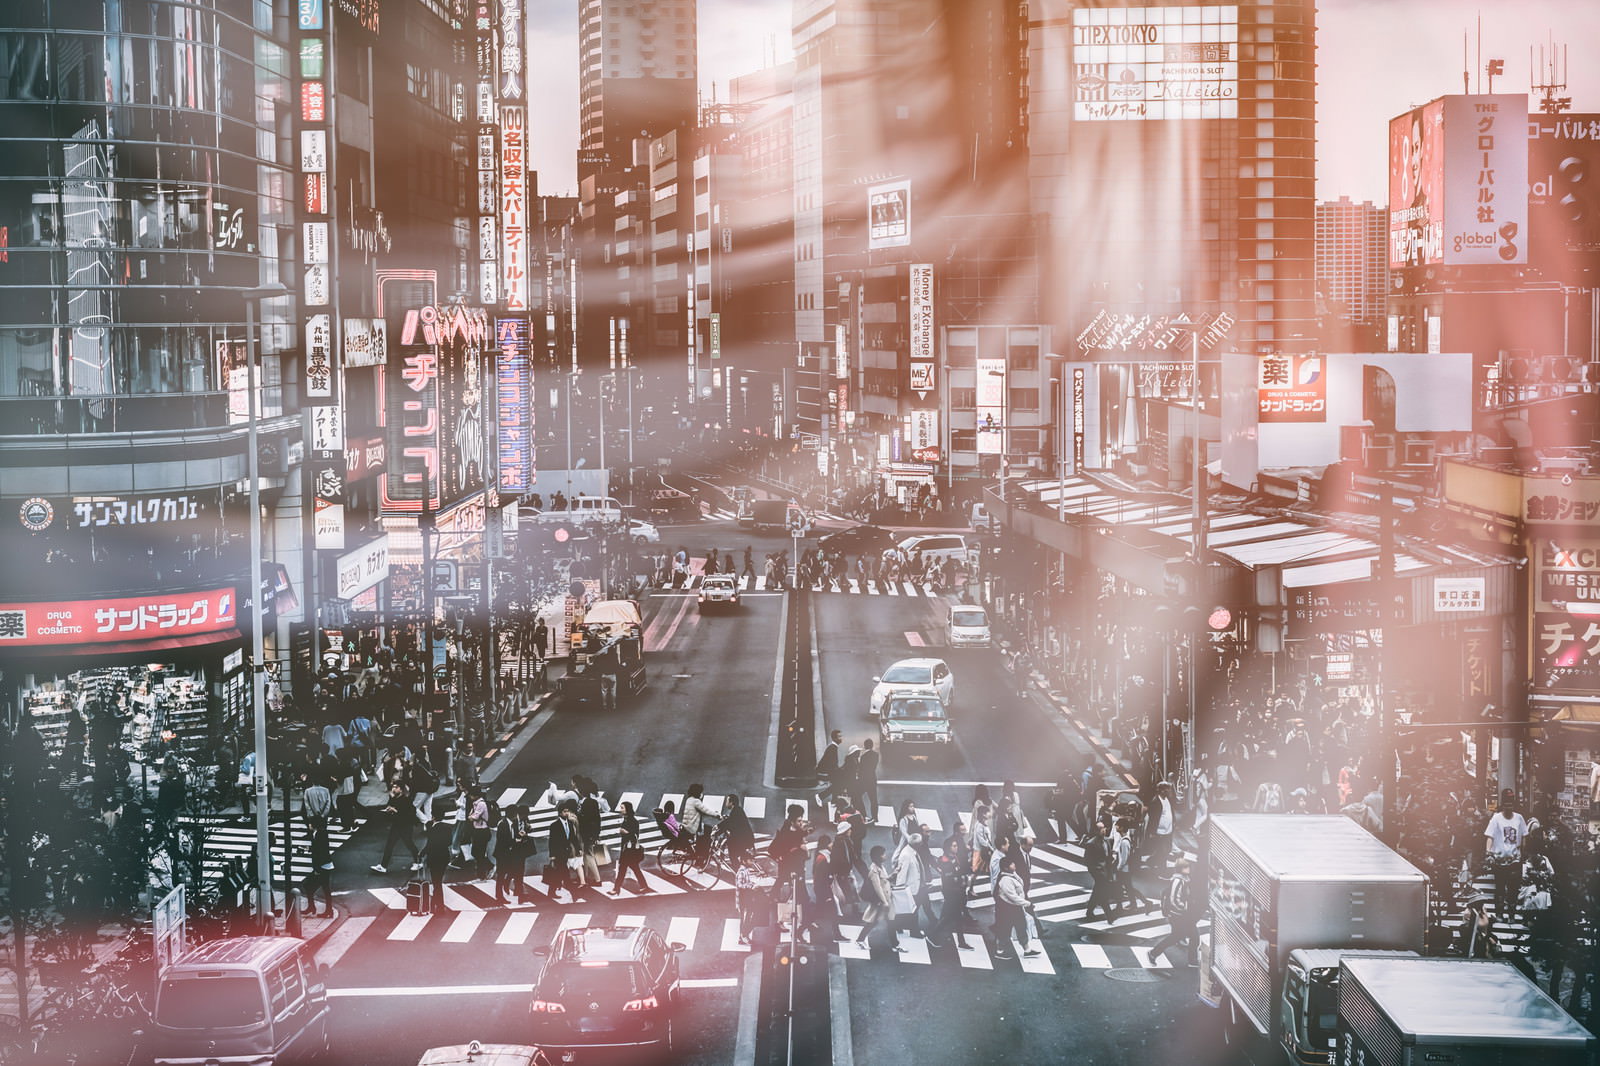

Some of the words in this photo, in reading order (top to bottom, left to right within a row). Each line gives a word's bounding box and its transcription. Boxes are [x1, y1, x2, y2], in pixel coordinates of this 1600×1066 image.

[1114, 26, 1158, 43] TOKYO
[1206, 67, 1225, 75] SLOT
[1153, 78, 1234, 99] Kaleido
[1474, 103, 1499, 113] THE
[479, 127, 492, 135] 4F
[1528, 117, 1600, 141] ローバル社
[1477, 116, 1495, 223] グローバル社
[503, 109, 524, 308] 100名収容大パーティールーム
[1453, 231, 1497, 253] global
[922, 268, 931, 302] Money
[1078, 314, 1119, 356] Kaleido
[1199, 311, 1236, 350] TIPNESS
[1263, 358, 1289, 385] 薬
[400, 306, 438, 484] パチンコ
[500, 312, 522, 488] パチンコジャンボ
[1260, 399, 1325, 412] サンドラッグ
[322, 450, 333, 459] B1
[73, 496, 199, 528] サンマルクカフェ
[0, 612, 24, 637] 薬
[47, 611, 73, 620] DRUG
[56, 619, 63, 627] &
[95, 599, 209, 633] サンドラッグ
[37, 625, 83, 635] COSMETIC
[1467, 638, 1482, 697] チケット
